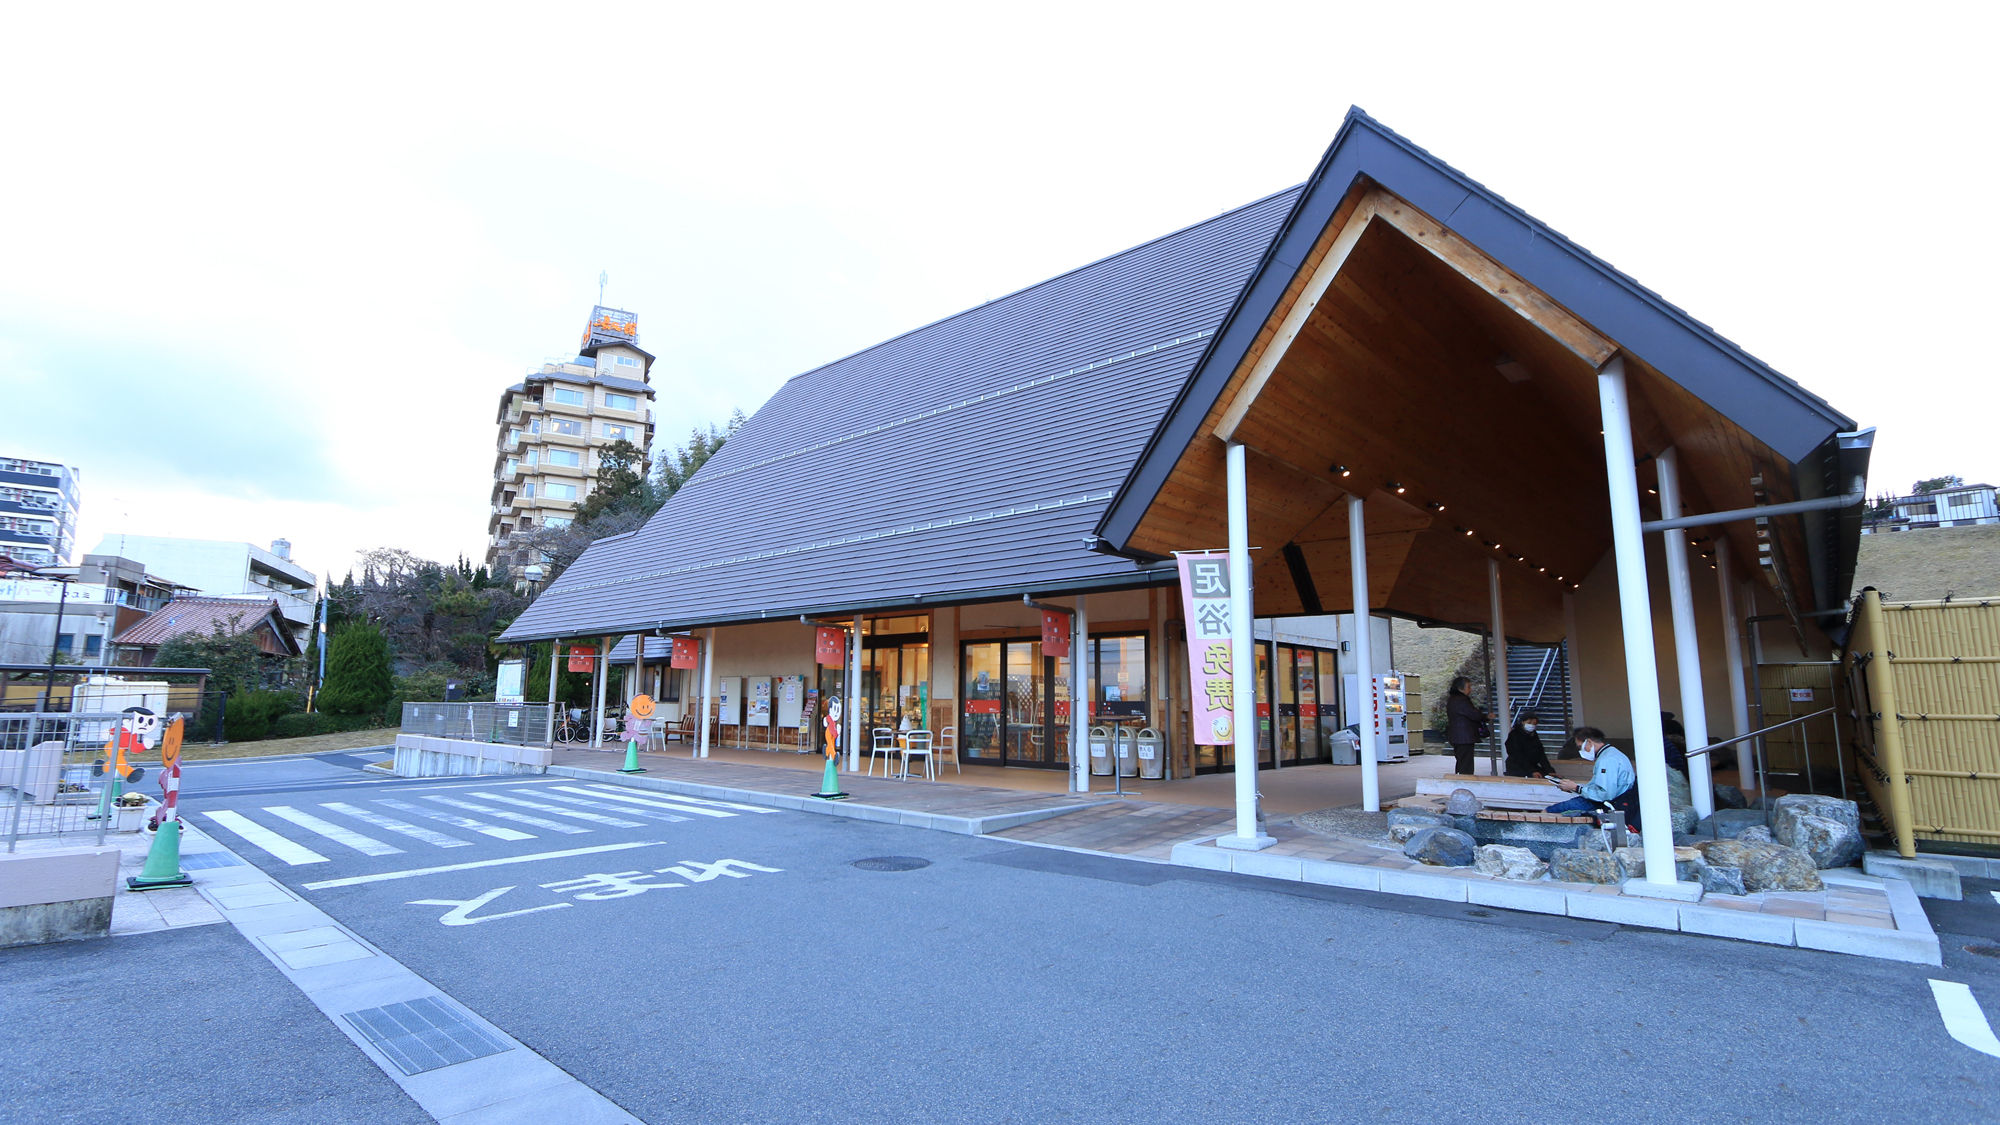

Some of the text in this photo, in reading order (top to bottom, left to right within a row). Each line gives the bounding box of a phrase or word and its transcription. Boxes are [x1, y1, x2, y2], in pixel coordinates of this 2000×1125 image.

[818, 646, 841, 654] COTTON
[405, 858, 786, 926] とまれ
